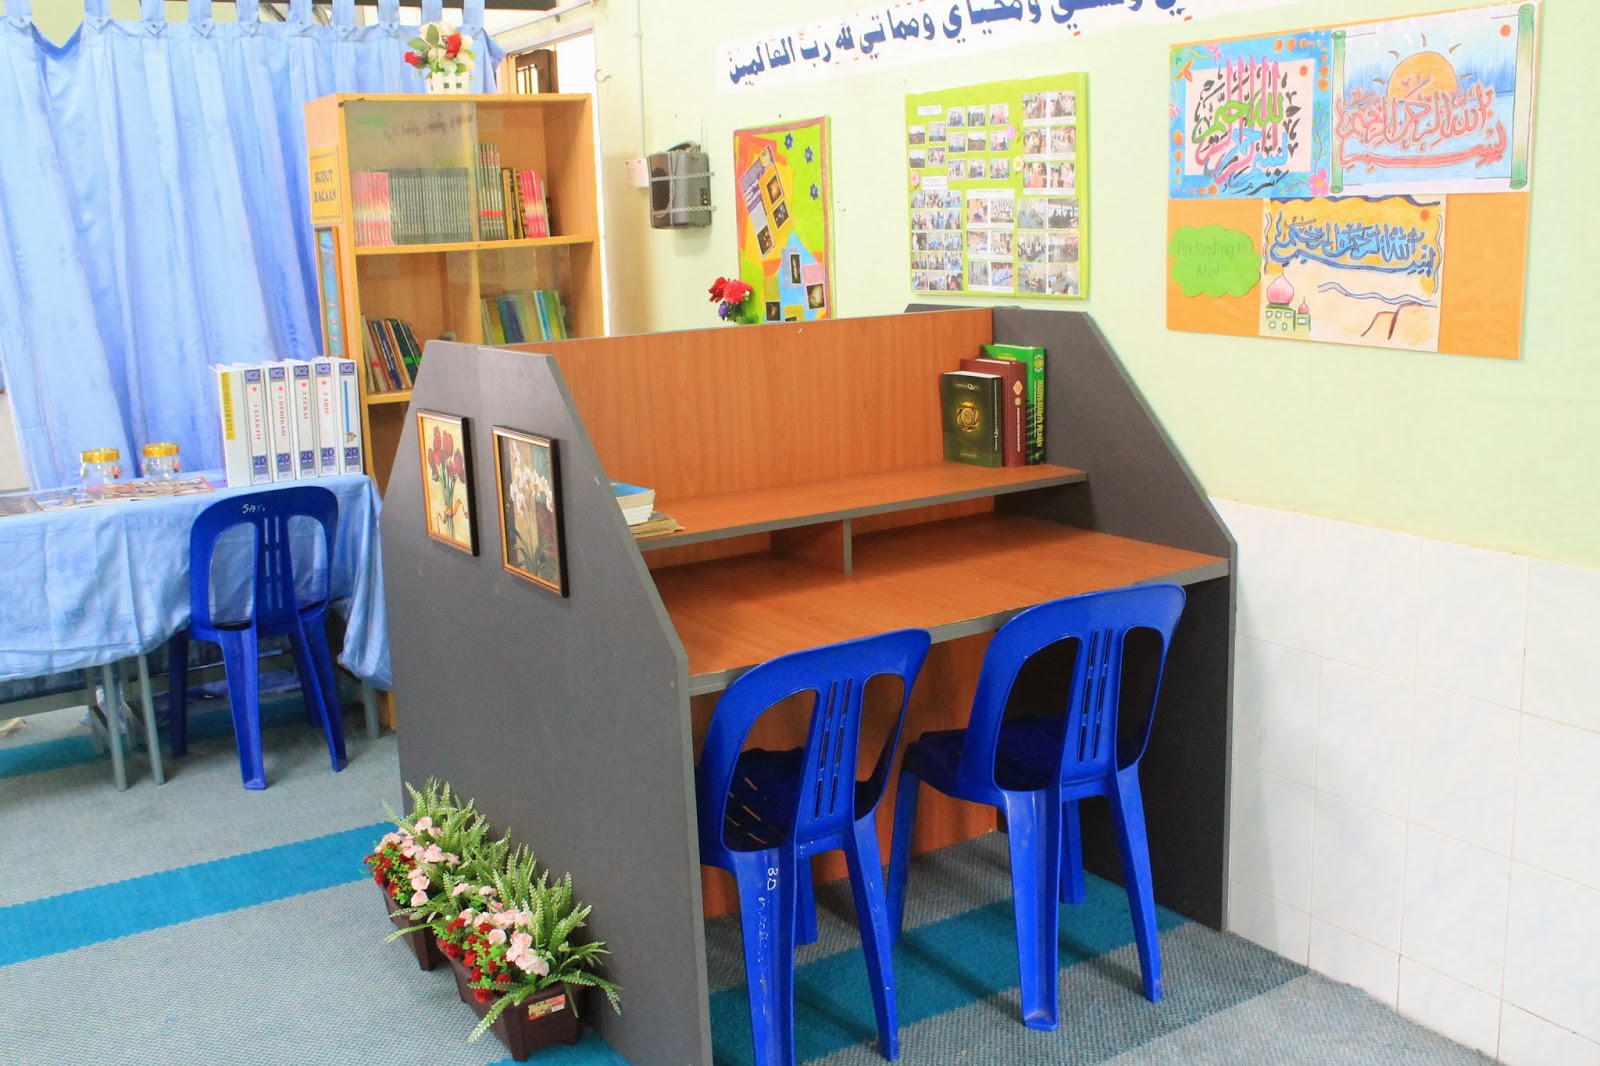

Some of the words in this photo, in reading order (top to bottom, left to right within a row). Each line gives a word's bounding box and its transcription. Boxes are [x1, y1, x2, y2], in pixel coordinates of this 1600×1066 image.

[314, 169, 333, 184] SUDUT
[313, 189, 337, 203] BACAAN
[1177, 238, 1249, 260] Pertandingan
[1196, 261, 1222, 279] Khat
